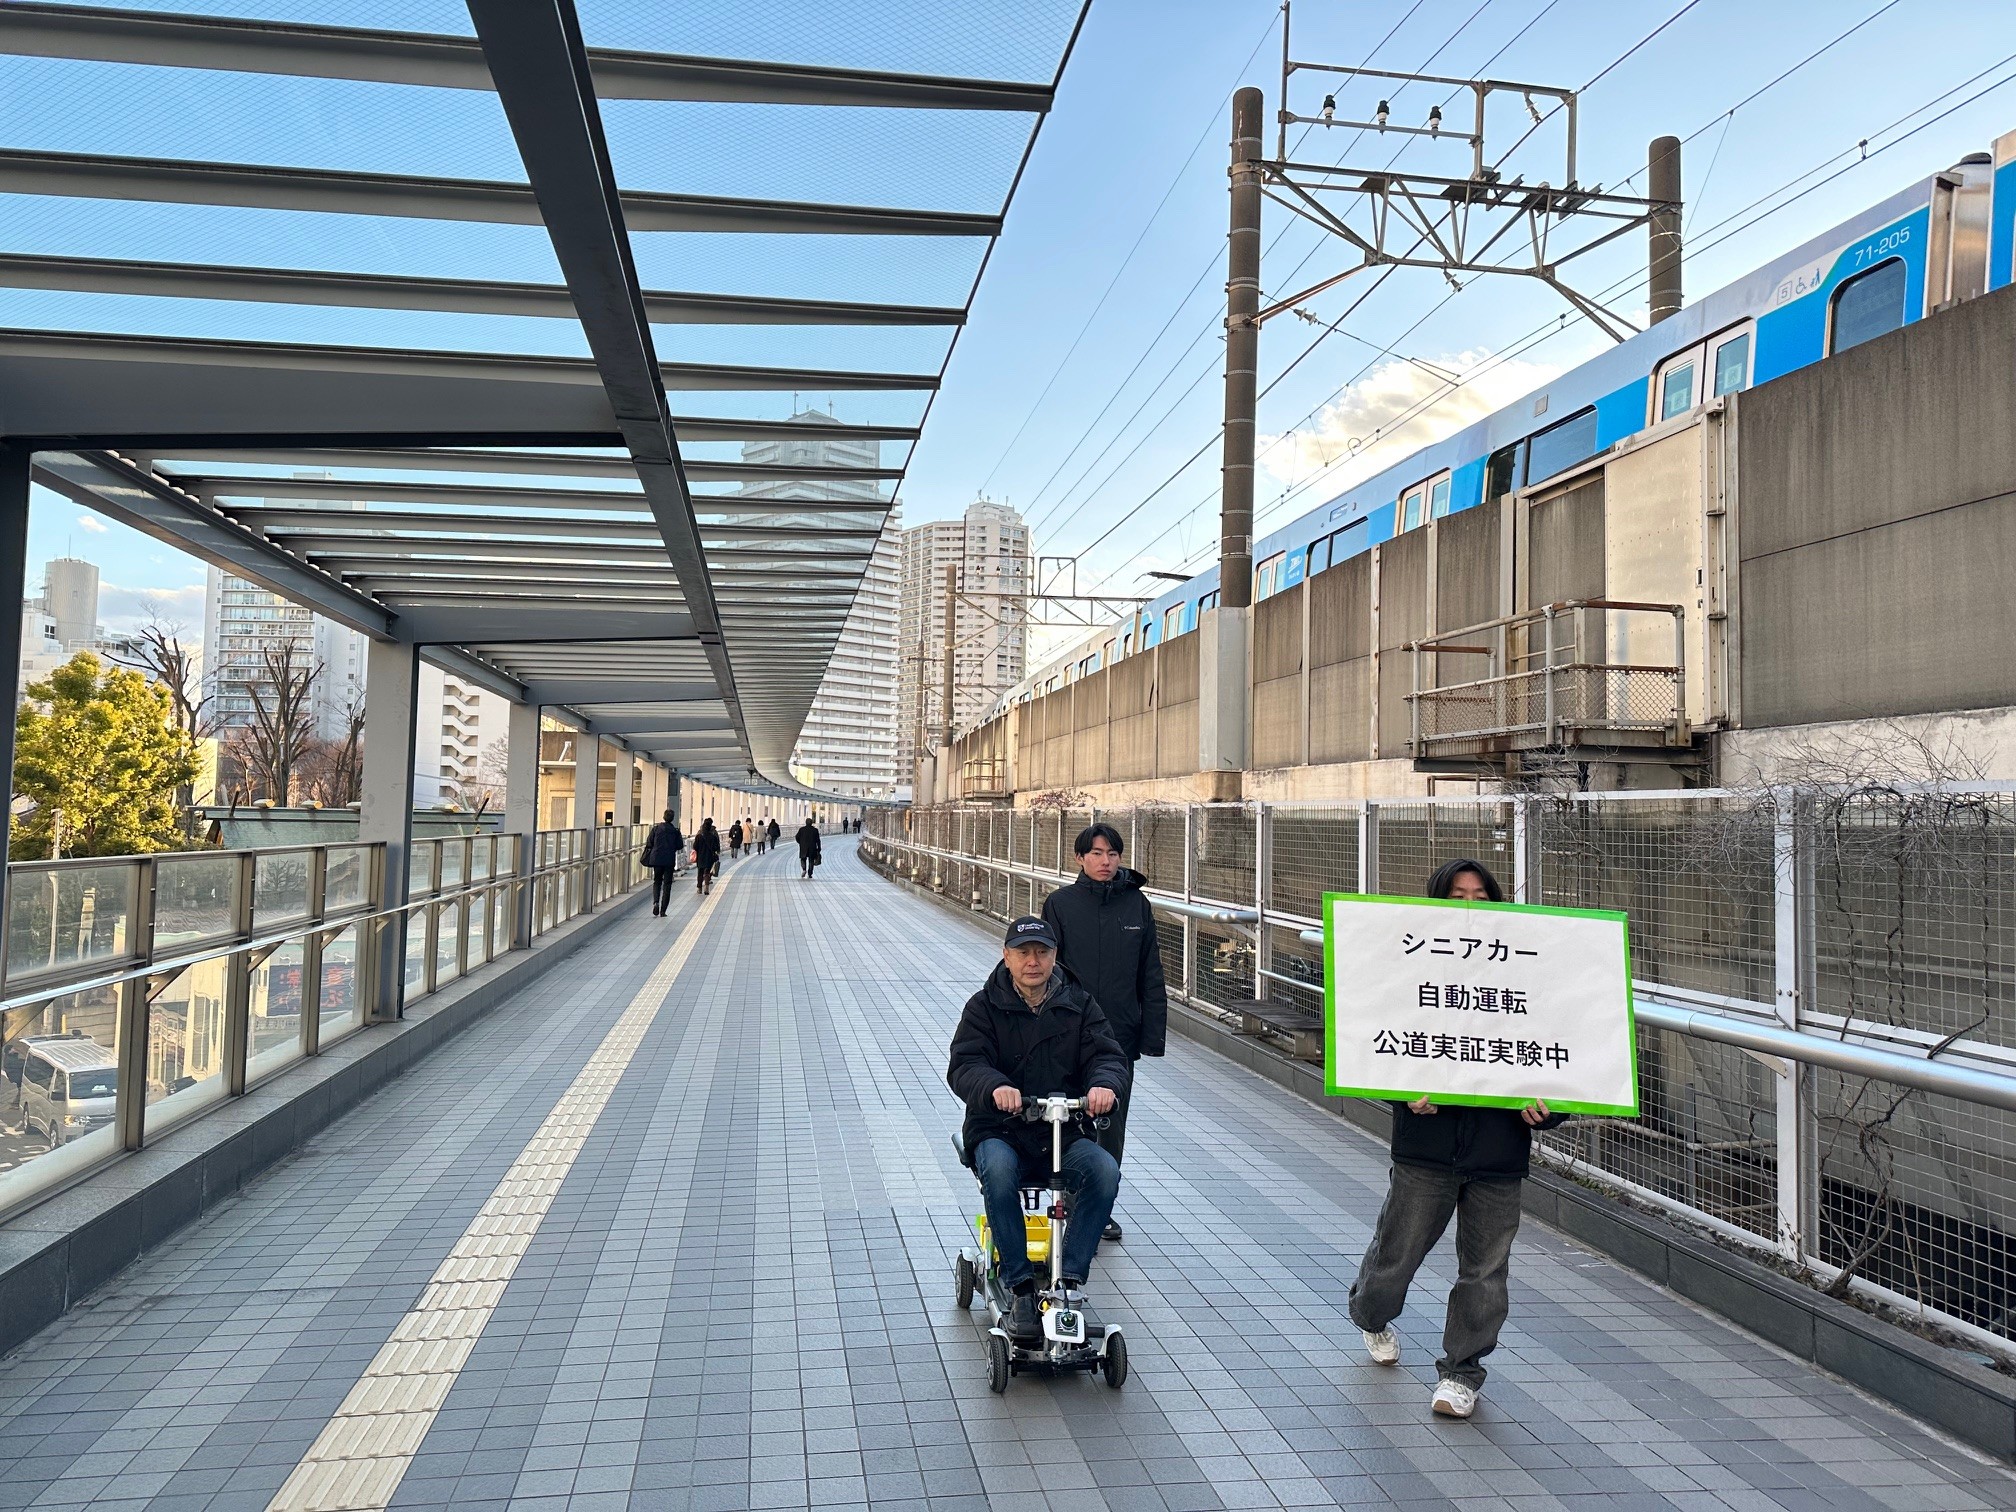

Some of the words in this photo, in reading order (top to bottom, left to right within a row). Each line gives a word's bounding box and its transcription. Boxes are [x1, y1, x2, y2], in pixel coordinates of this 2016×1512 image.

[1855, 226, 1910, 267] 71-205
[1401, 932, 1539, 962] シニアカー
[1417, 980, 1529, 1015] 自動運転
[1371, 1028, 1570, 1070] 公道実証実験中
